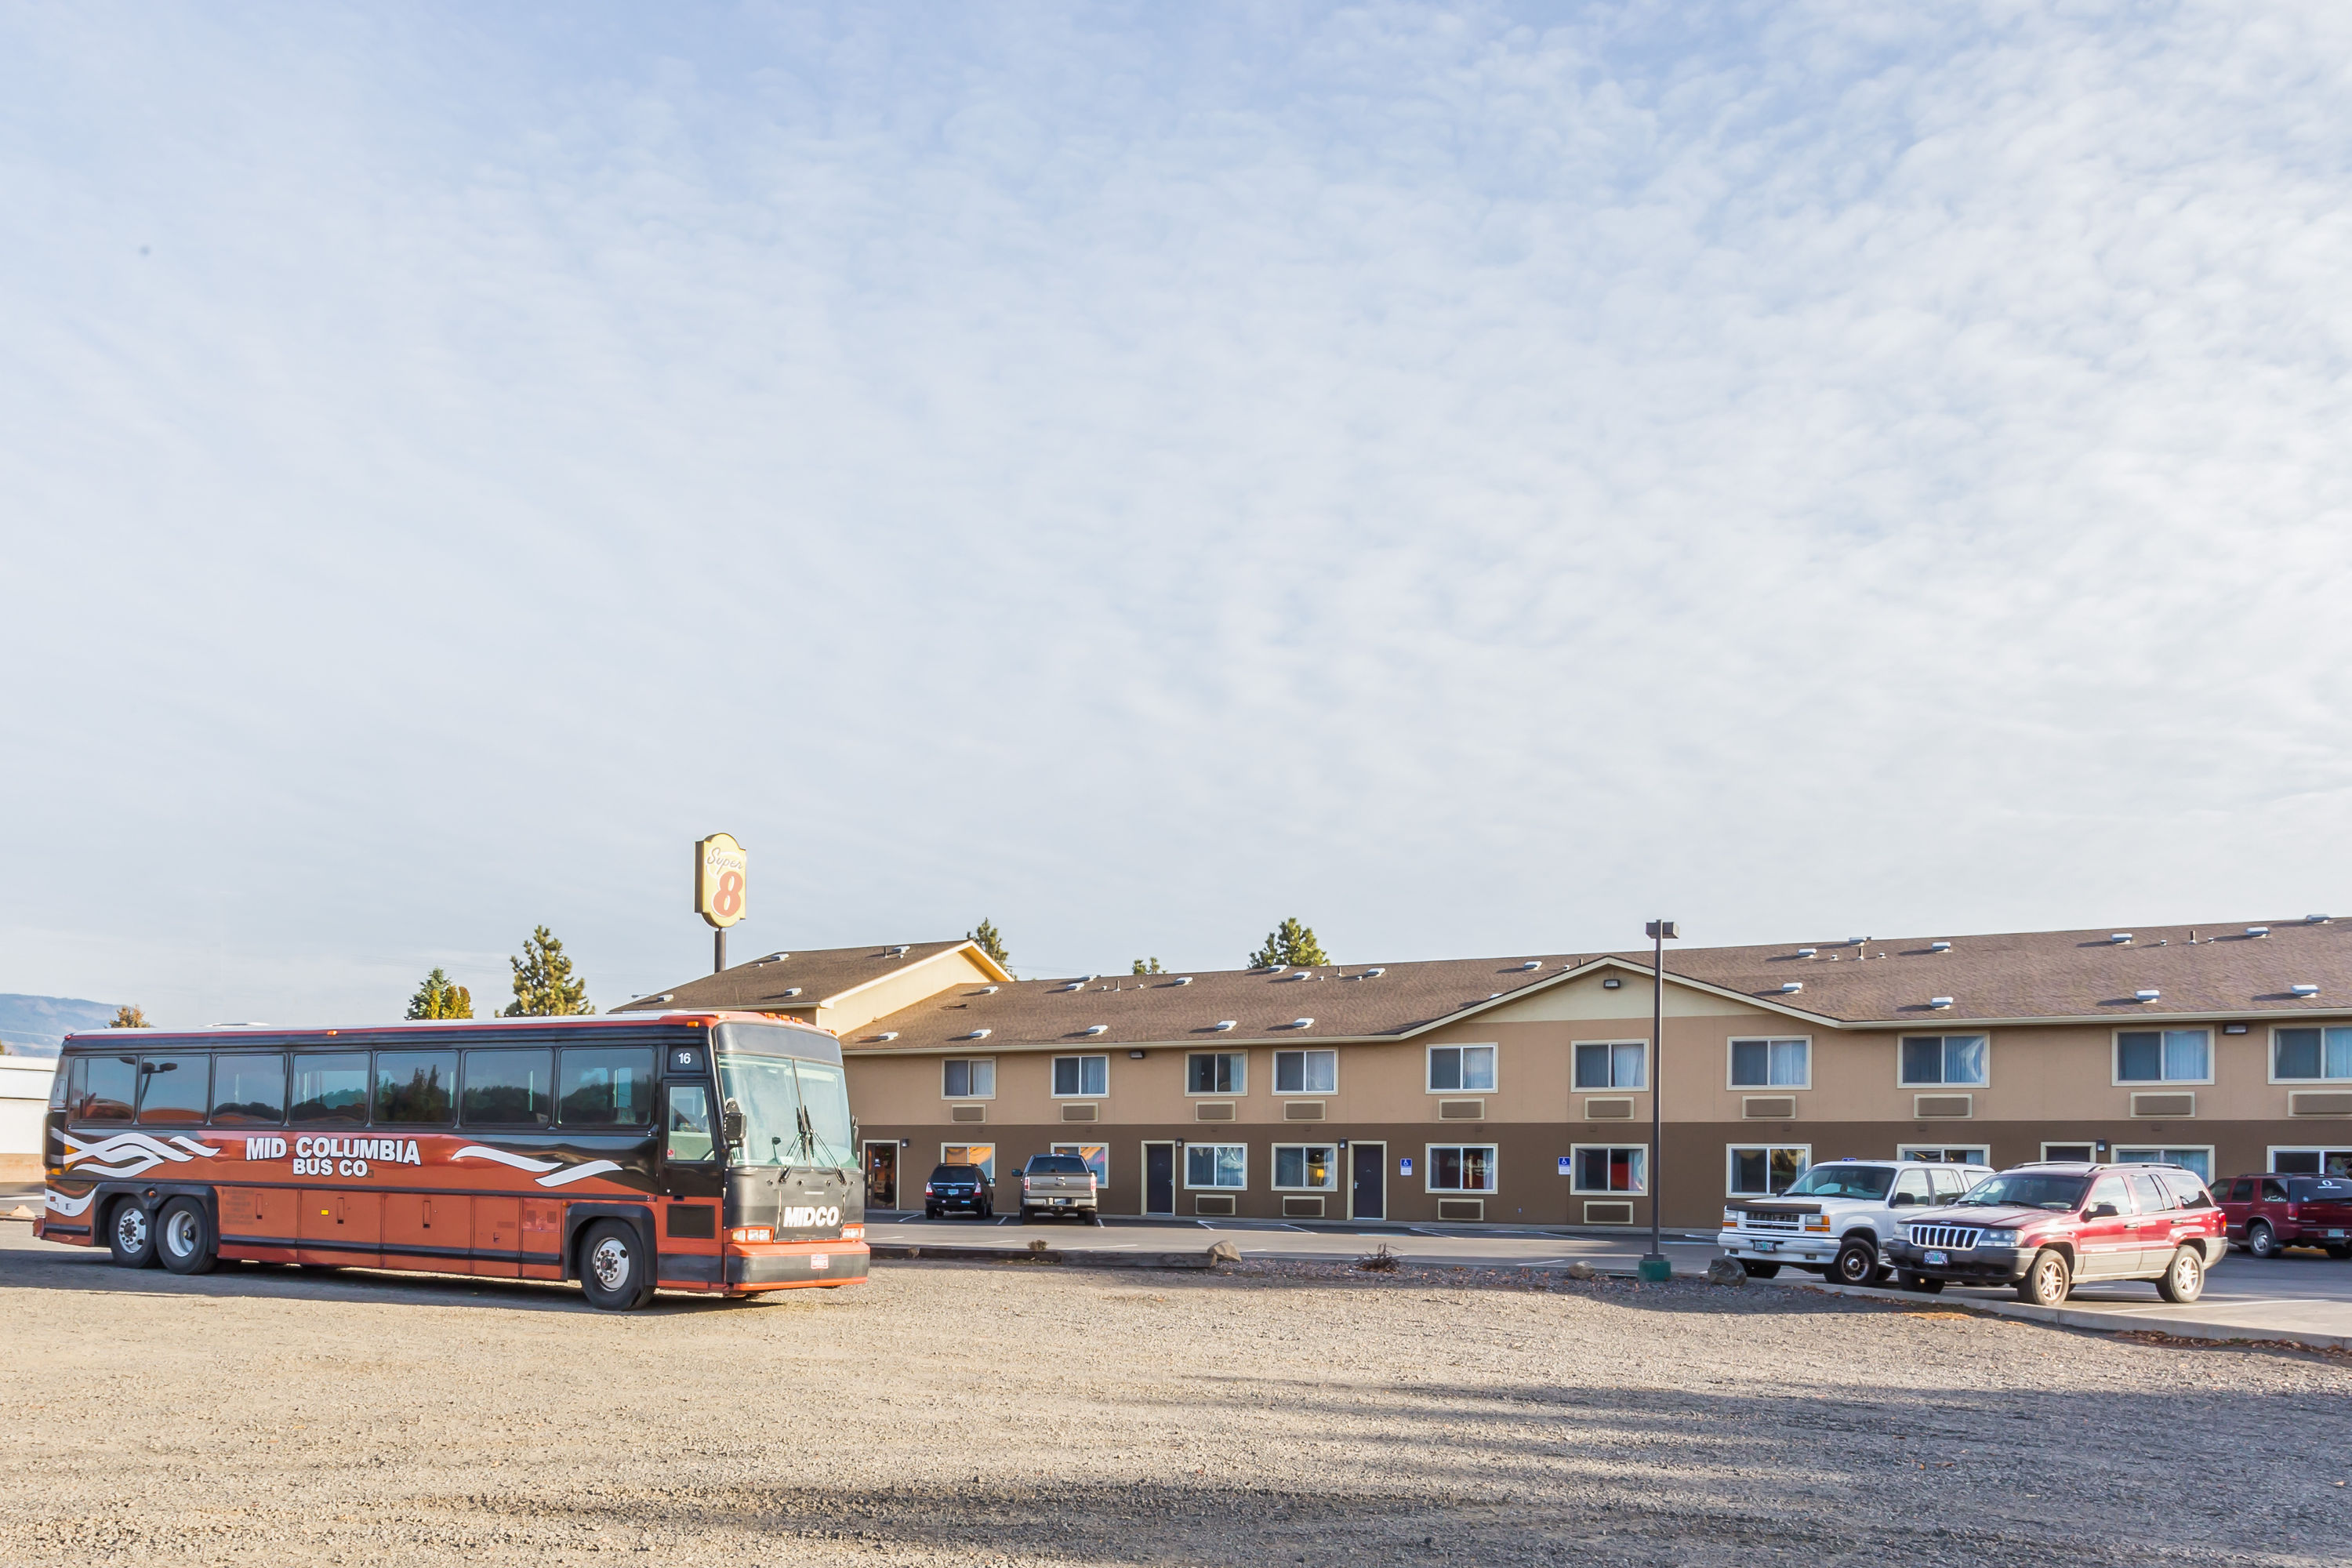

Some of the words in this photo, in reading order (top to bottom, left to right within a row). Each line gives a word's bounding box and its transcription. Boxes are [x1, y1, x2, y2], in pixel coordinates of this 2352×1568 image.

[706, 847, 744, 876] Super
[712, 870, 743, 917] 8
[678, 1052, 691, 1065] 16
[245, 1136, 288, 1161] MID
[295, 1136, 422, 1166] COLUMBIA
[292, 1157, 334, 1176] BUS
[338, 1159, 368, 1178] CO
[782, 1206, 840, 1228] MIDCO
